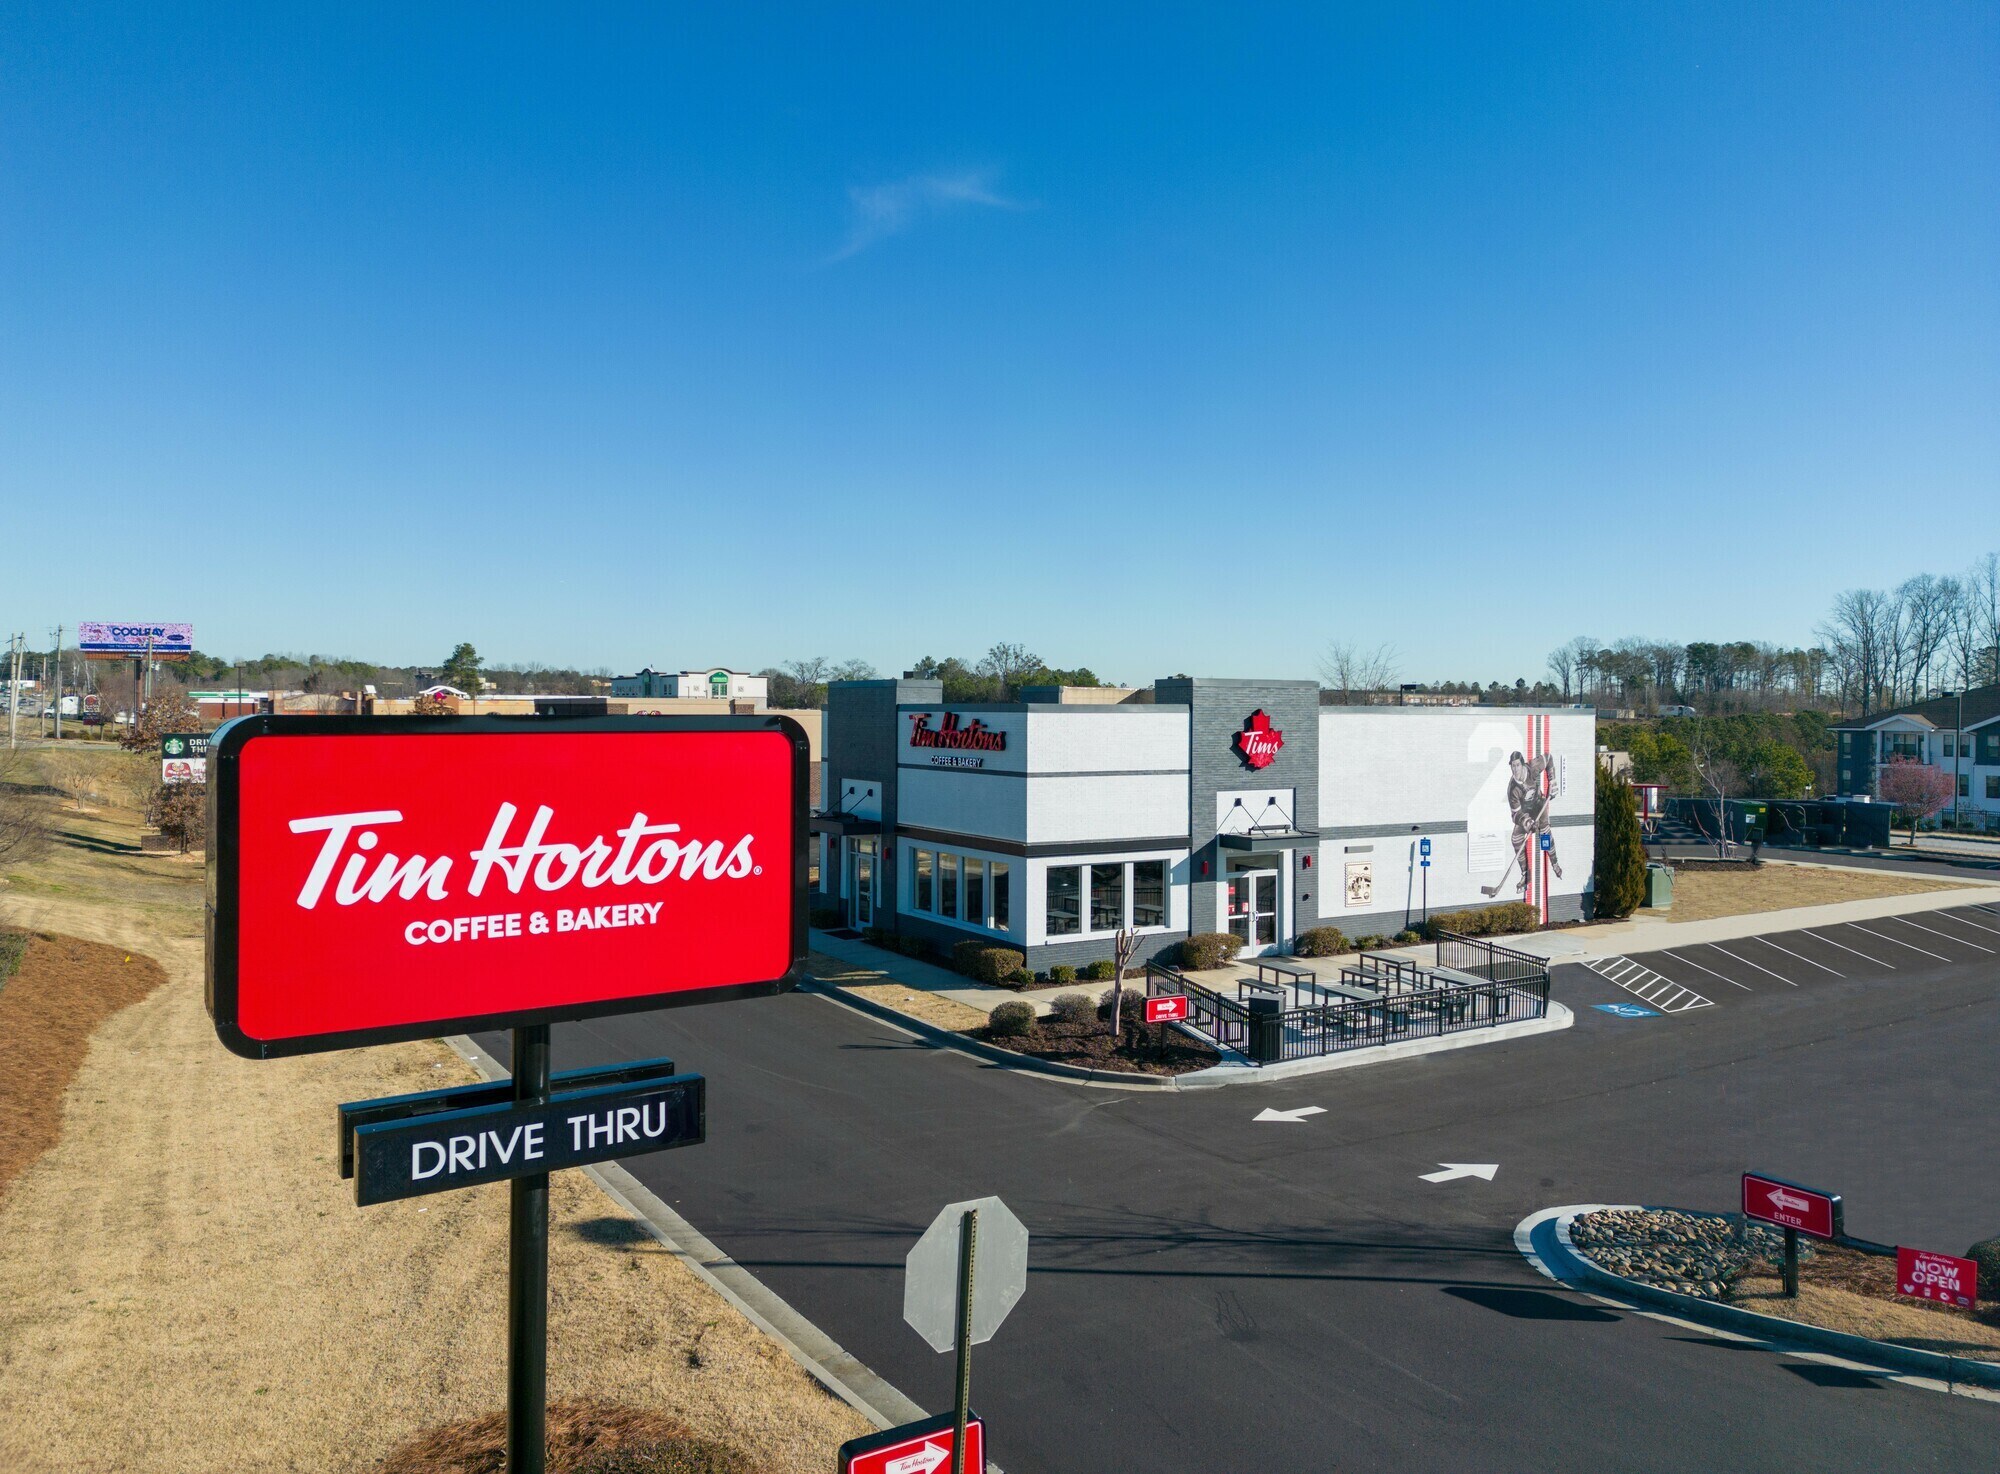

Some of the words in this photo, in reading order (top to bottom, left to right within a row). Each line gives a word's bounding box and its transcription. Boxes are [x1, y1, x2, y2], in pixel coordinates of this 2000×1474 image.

[909, 713, 936, 748] Tim
[938, 712, 1007, 751] Hortons
[1245, 731, 1279, 754] Tims
[931, 756, 952, 766] COFFEE
[958, 758, 982, 767] BAKERY
[289, 810, 453, 909] Tim
[404, 913, 522, 945] COFFEE
[528, 911, 549, 934] &
[556, 902, 664, 932] BAKERY
[412, 1123, 544, 1180] DRIVE
[567, 1102, 666, 1151] THRU
[1774, 1212, 1802, 1226] ENTER
[1915, 1260, 1959, 1278] NOW
[1912, 1272, 1960, 1291] OPEN
[900, 1462, 911, 1471] Tim
[912, 1457, 935, 1467] Hortons
